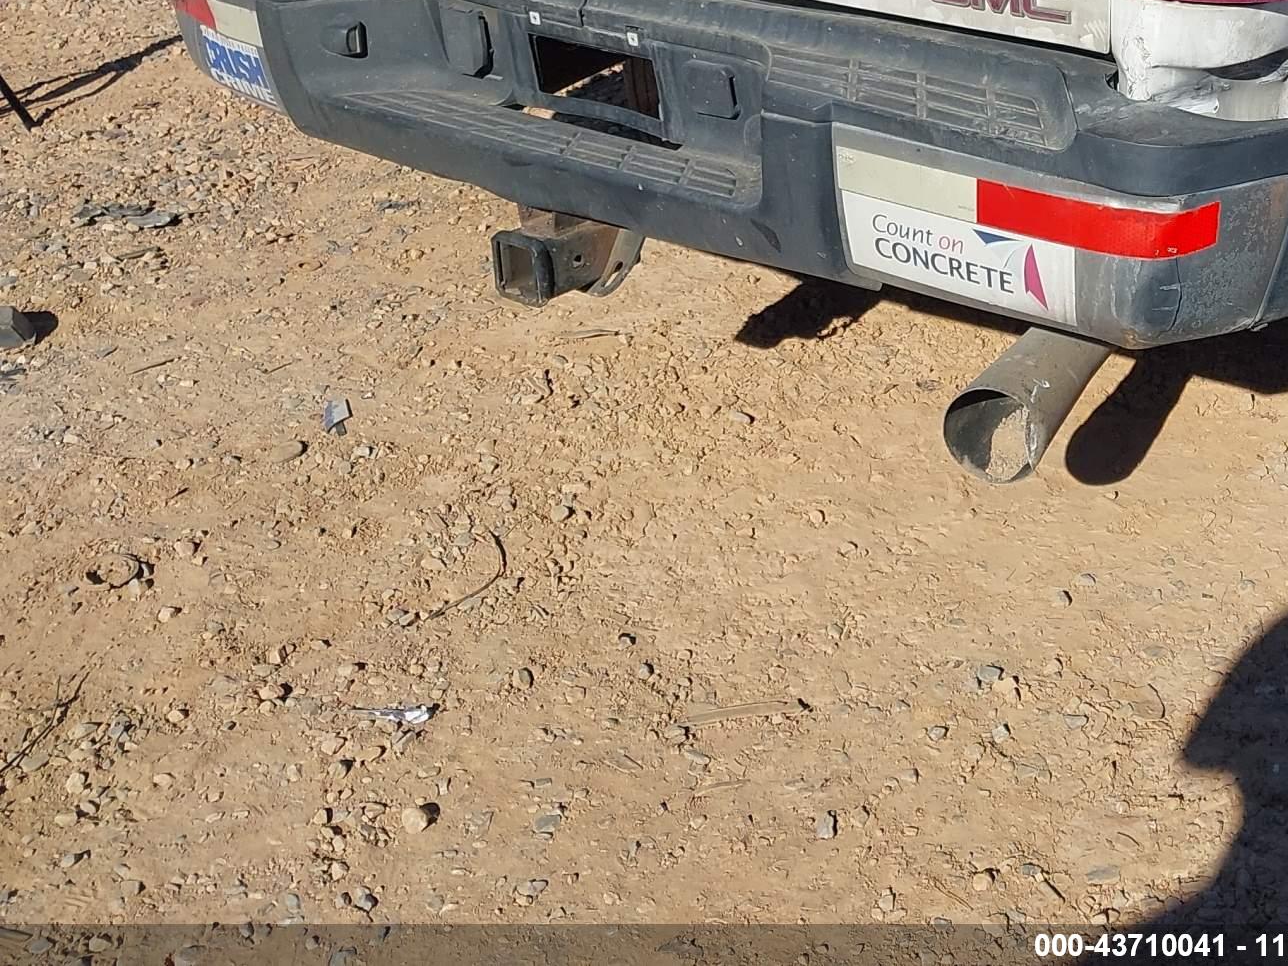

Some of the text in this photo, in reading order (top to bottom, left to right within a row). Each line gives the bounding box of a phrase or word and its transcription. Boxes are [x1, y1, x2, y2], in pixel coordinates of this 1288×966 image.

[872, 214, 964, 254] Count on
[875, 237, 1015, 294] CONCRETE
